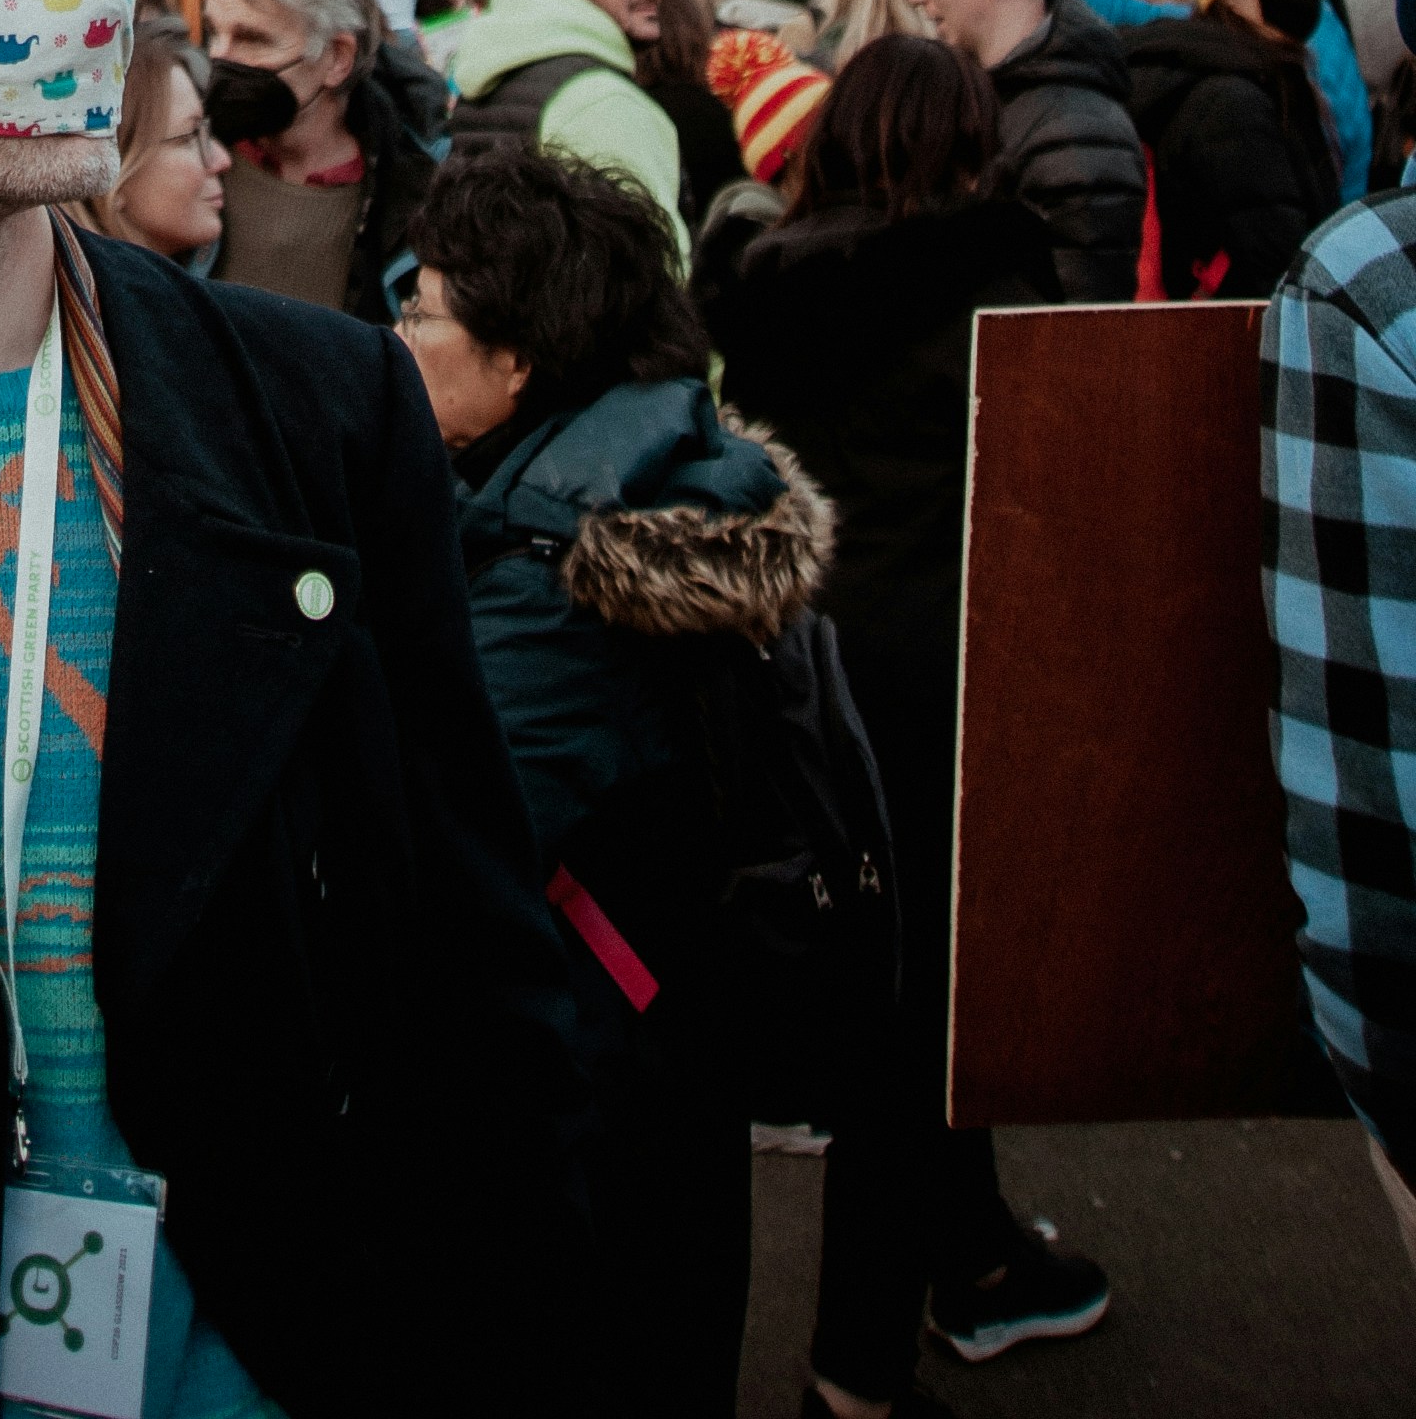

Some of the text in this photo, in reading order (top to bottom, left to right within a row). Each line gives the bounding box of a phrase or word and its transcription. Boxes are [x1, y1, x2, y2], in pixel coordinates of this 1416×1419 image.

[18, 551, 42, 754] SCOTTISH GREEN PARTY
